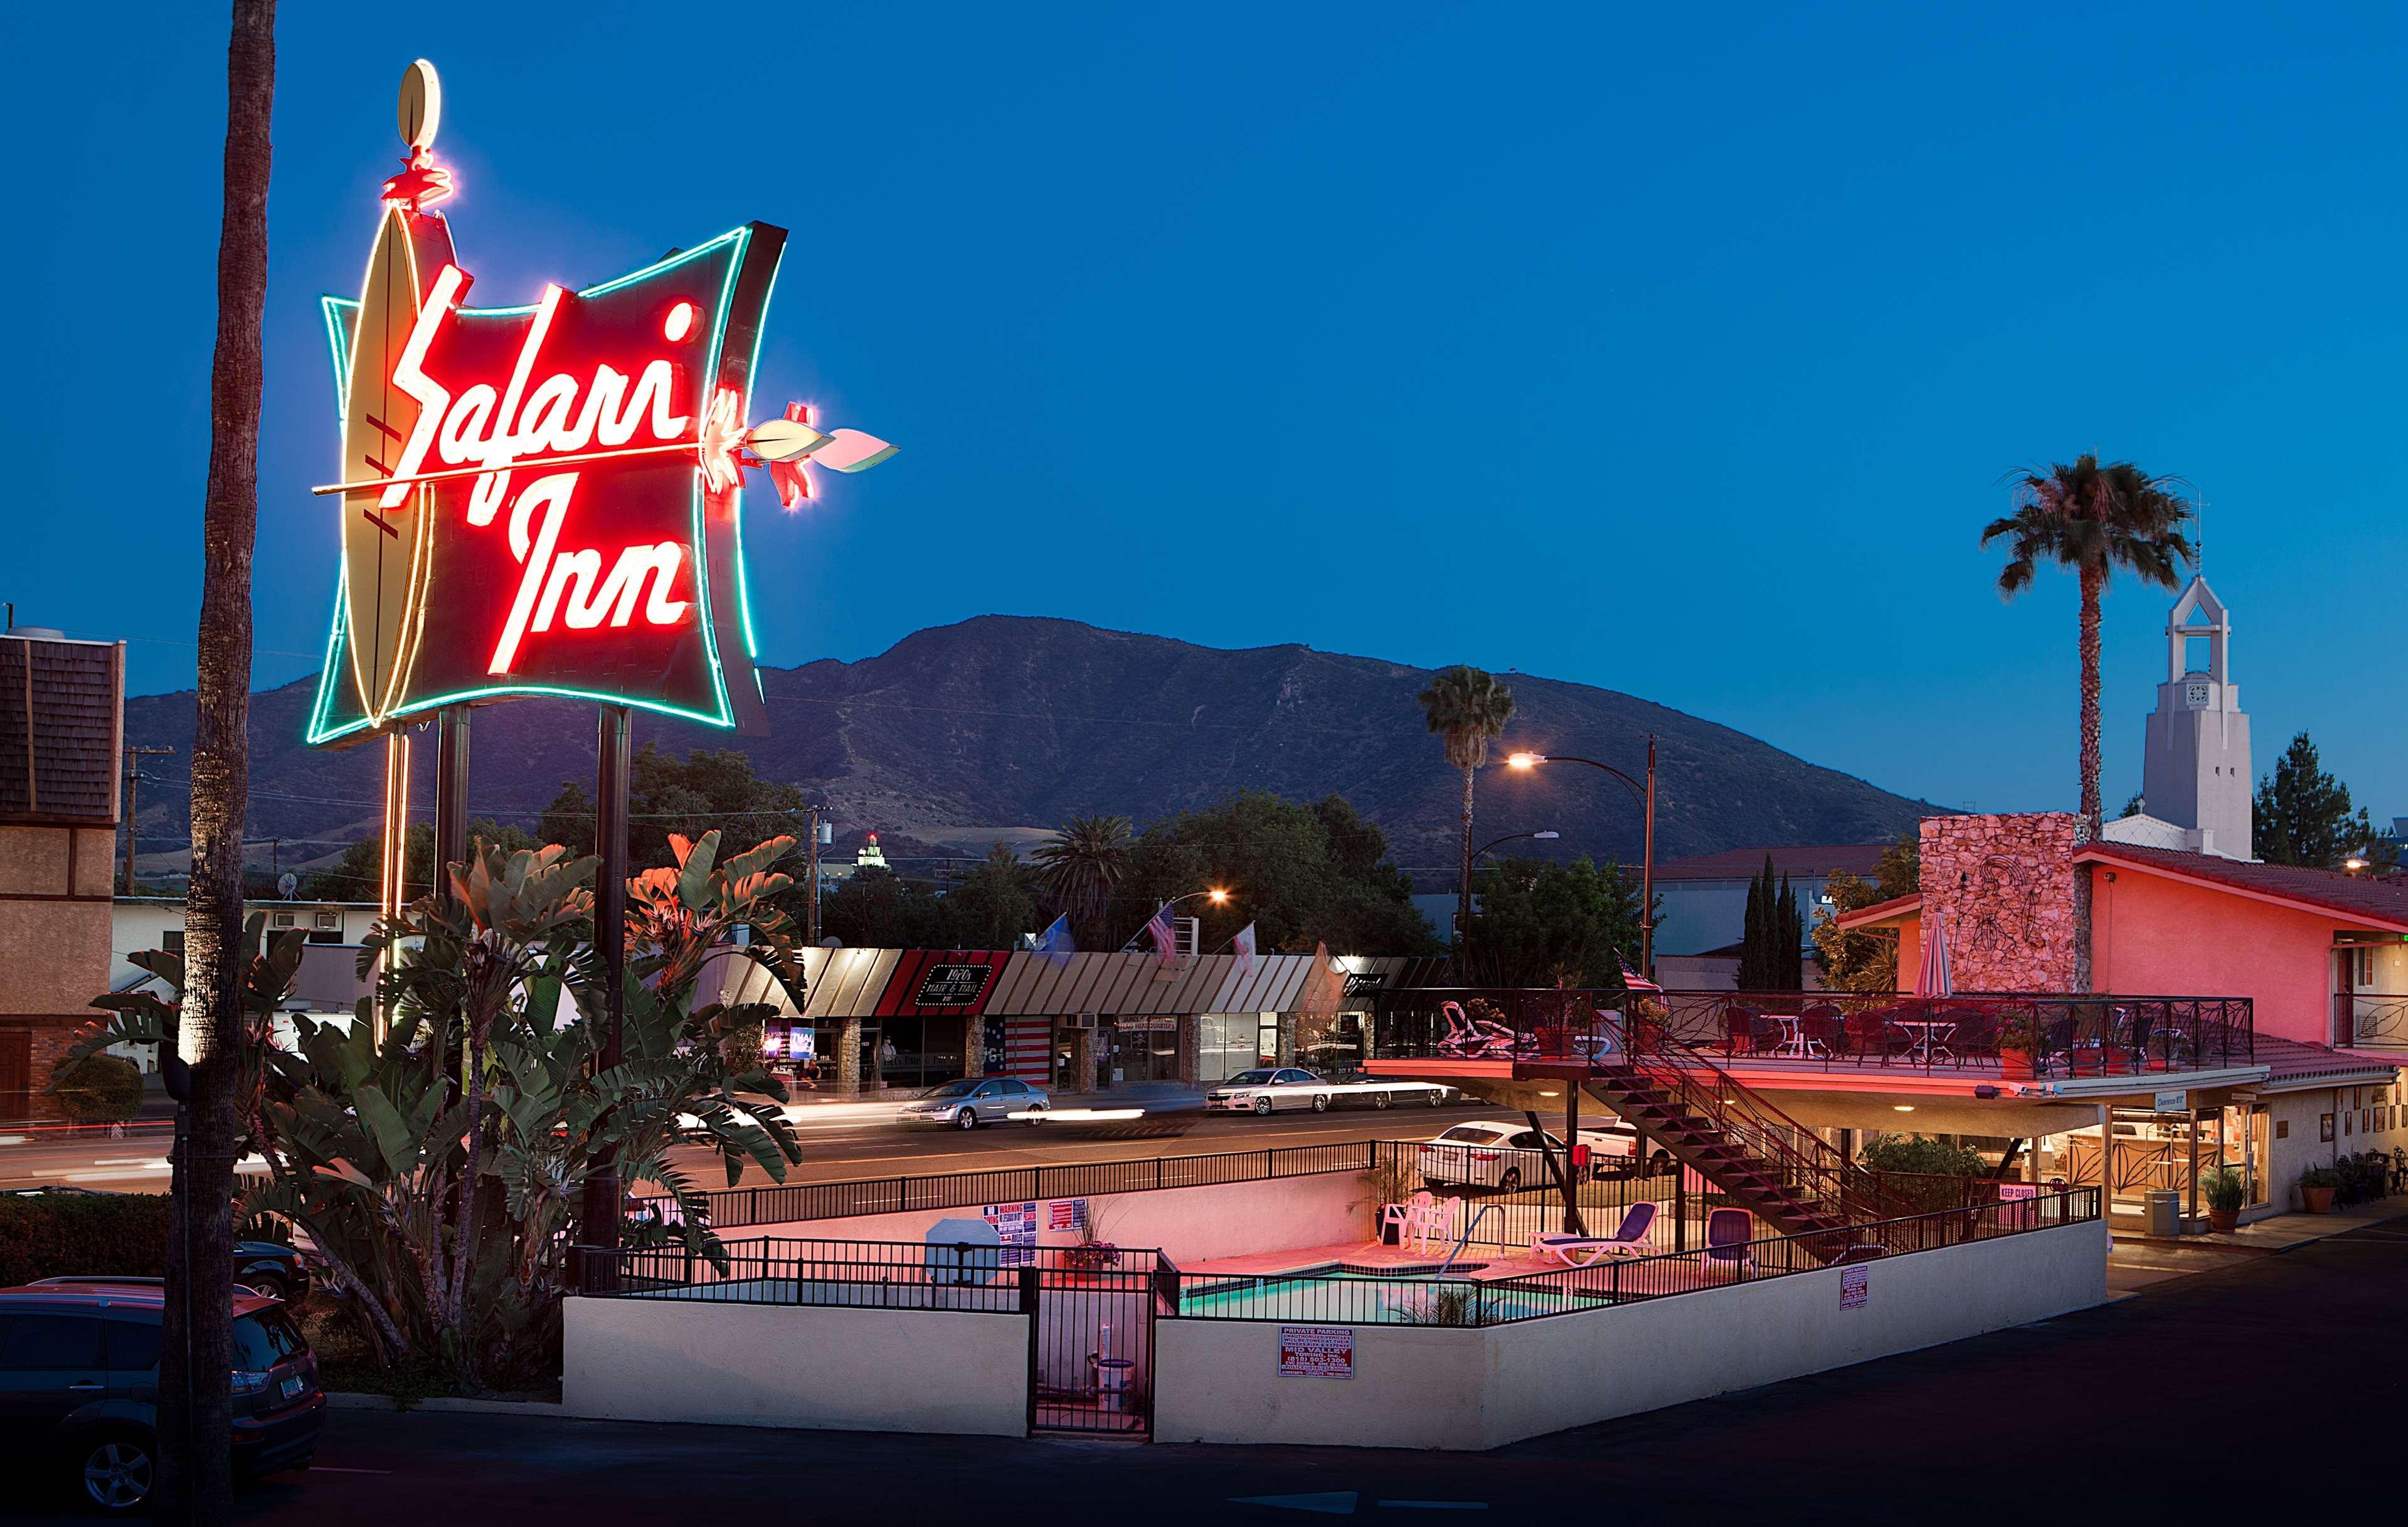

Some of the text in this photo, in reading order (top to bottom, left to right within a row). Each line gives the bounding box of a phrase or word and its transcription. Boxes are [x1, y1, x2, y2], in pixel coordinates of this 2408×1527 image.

[379, 265, 695, 527] Safari
[487, 472, 687, 676] Inn
[947, 969, 972, 981] 1920s
[950, 984, 956, 992] &
[2002, 1188, 2034, 1198] KEEP CLOSED
[987, 1206, 995, 1216] NO
[999, 1204, 1023, 1214] WARNING
[1012, 1234, 1022, 1243] RULES
